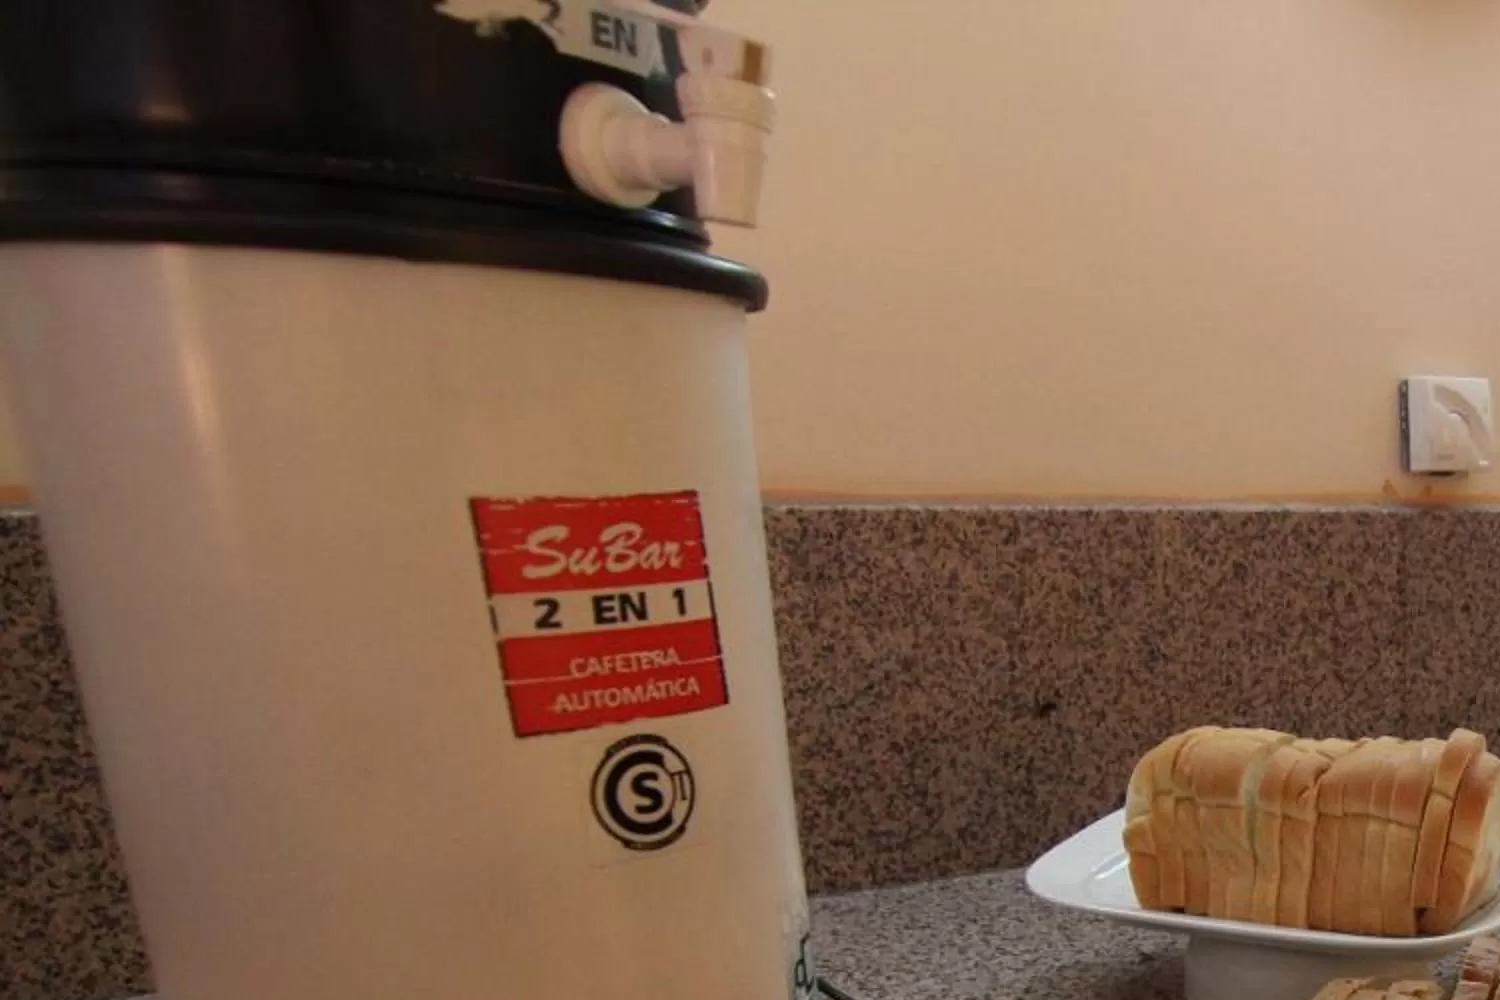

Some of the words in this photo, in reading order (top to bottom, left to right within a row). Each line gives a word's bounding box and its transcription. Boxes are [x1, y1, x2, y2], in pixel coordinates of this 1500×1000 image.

[590, 11, 638, 57] EN
[533, 598, 562, 629] 2
[592, 591, 649, 625] EN
[672, 588, 687, 616] 1
[569, 648, 680, 678] CAFETERA
